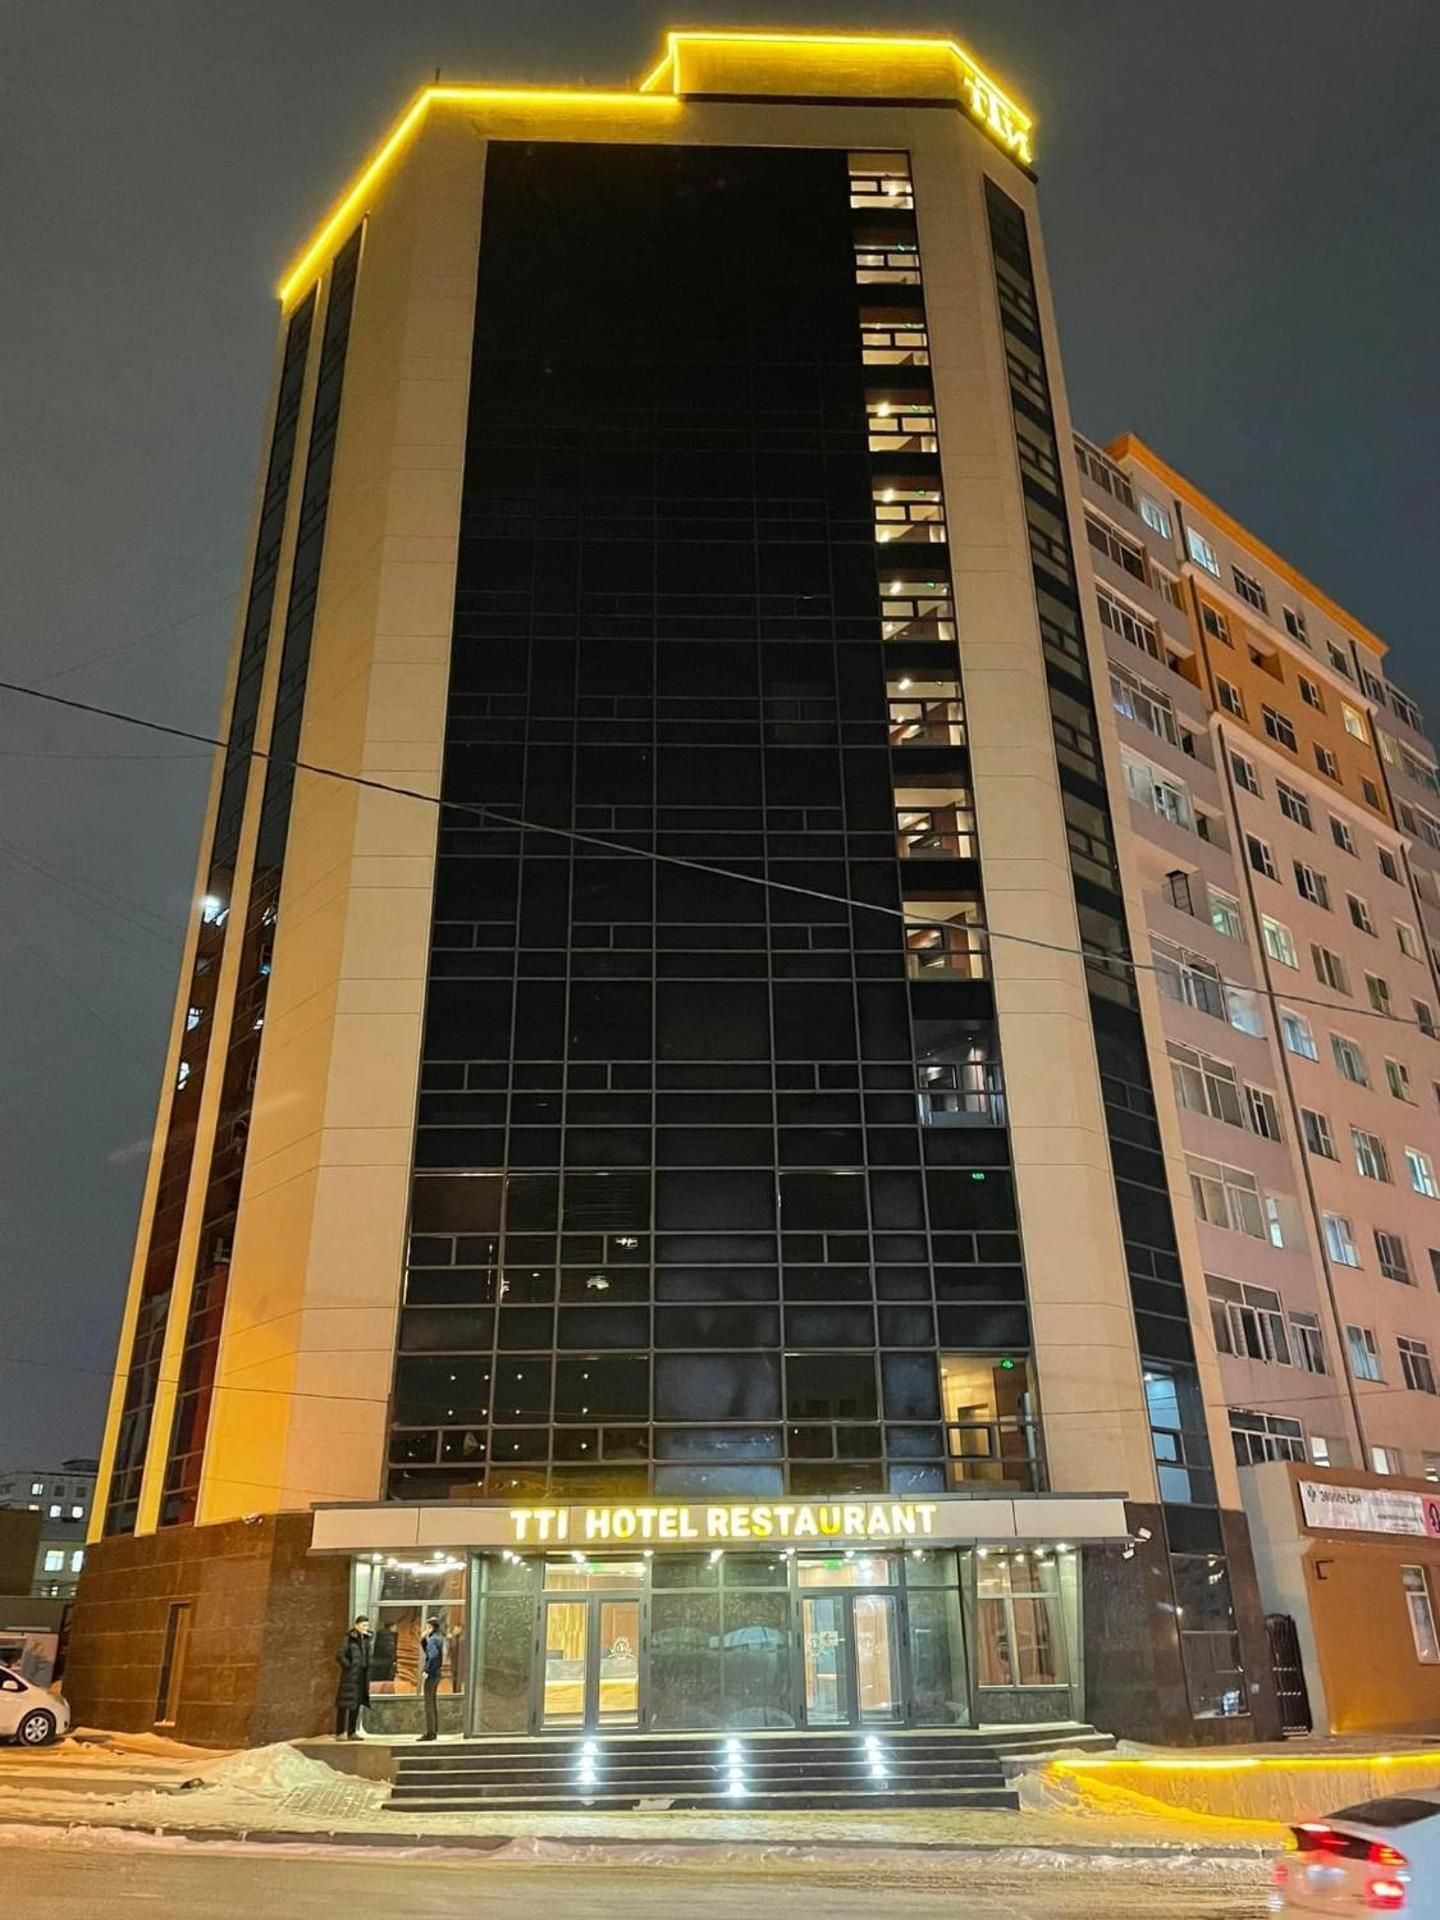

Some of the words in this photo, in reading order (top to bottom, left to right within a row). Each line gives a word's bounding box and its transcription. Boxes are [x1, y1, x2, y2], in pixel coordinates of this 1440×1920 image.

[510, 1510, 569, 1540] TTI
[586, 1507, 699, 1537] HOTEL
[706, 1504, 938, 1537] RESTAURANT
